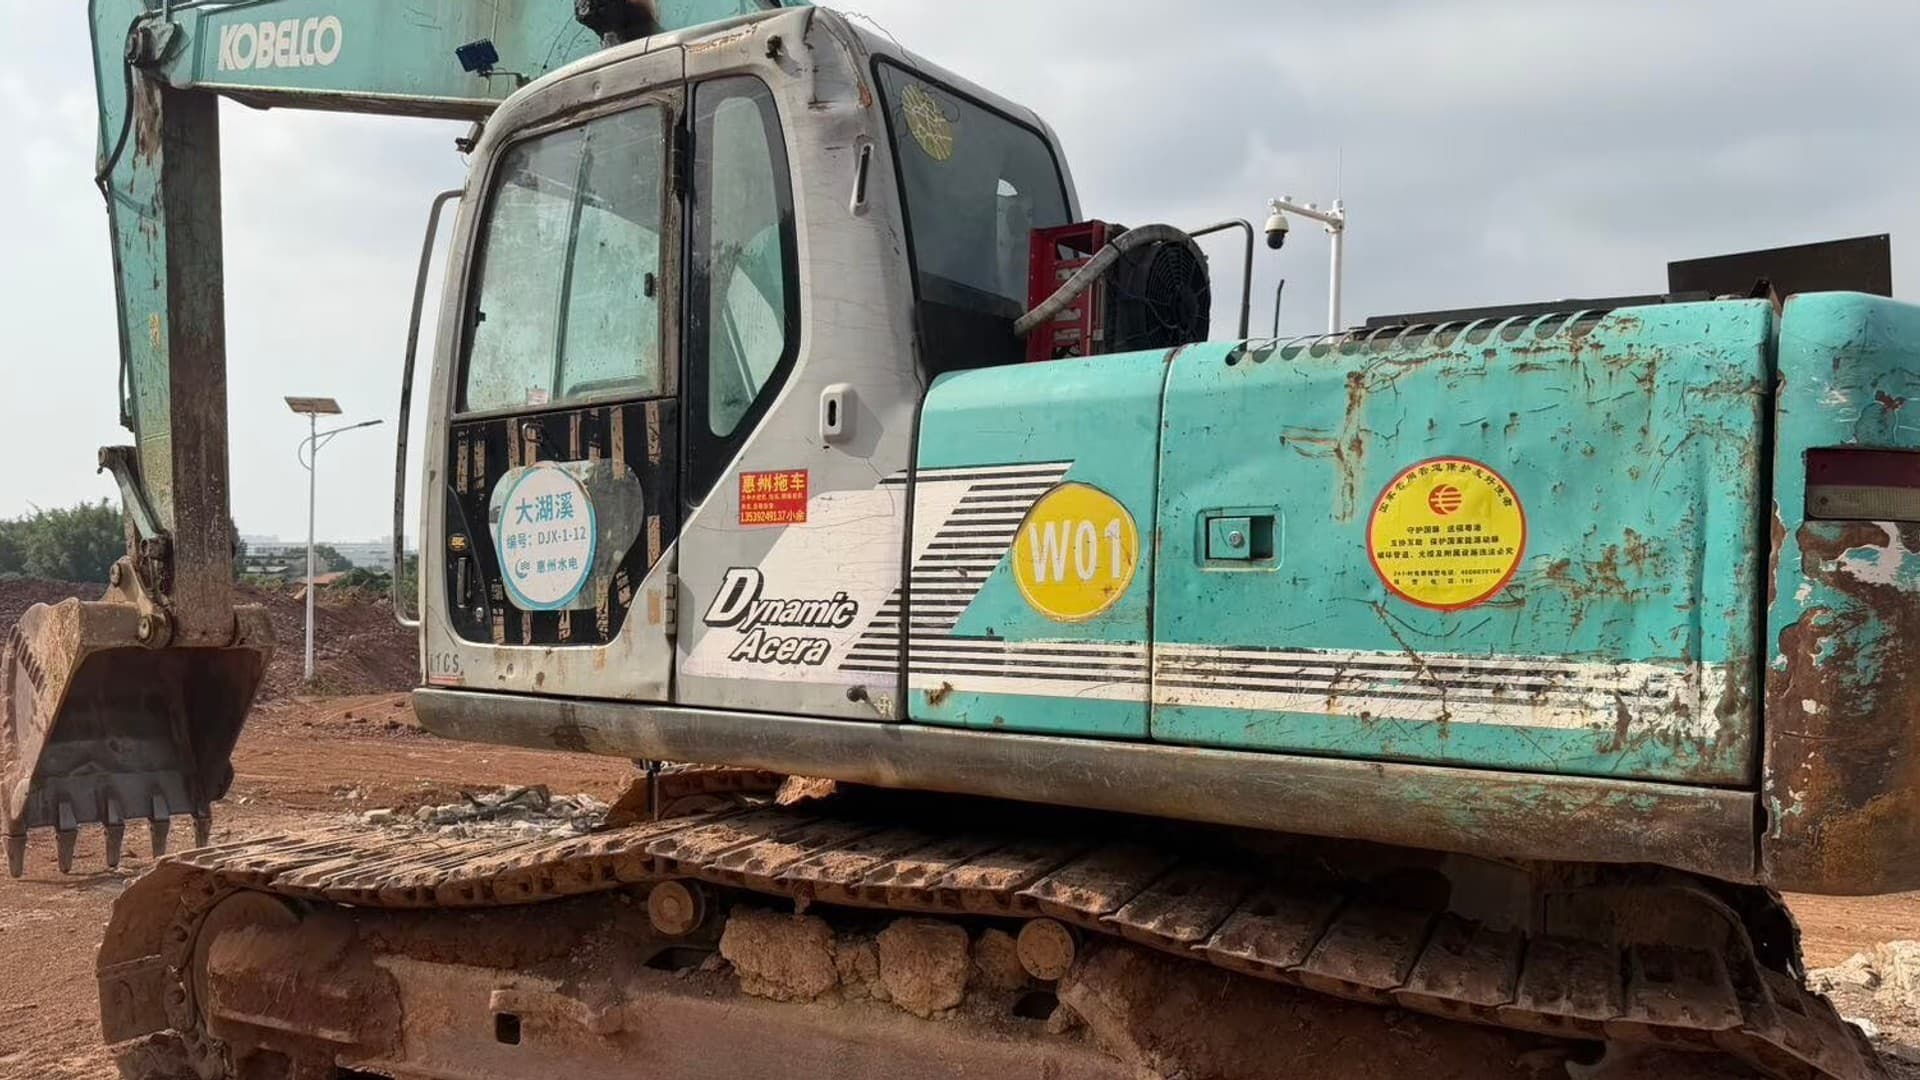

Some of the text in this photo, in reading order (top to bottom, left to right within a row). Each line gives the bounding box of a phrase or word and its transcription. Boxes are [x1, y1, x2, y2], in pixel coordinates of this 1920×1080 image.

[218, 15, 342, 71] KOBELCO
[742, 473, 805, 492] 惠州拖车
[515, 491, 574, 525] 大湖溪
[536, 556, 578, 573] 惠州水电
[1029, 518, 1122, 583] W01
[704, 567, 858, 632] Dynamic
[729, 628, 832, 666] Acera
